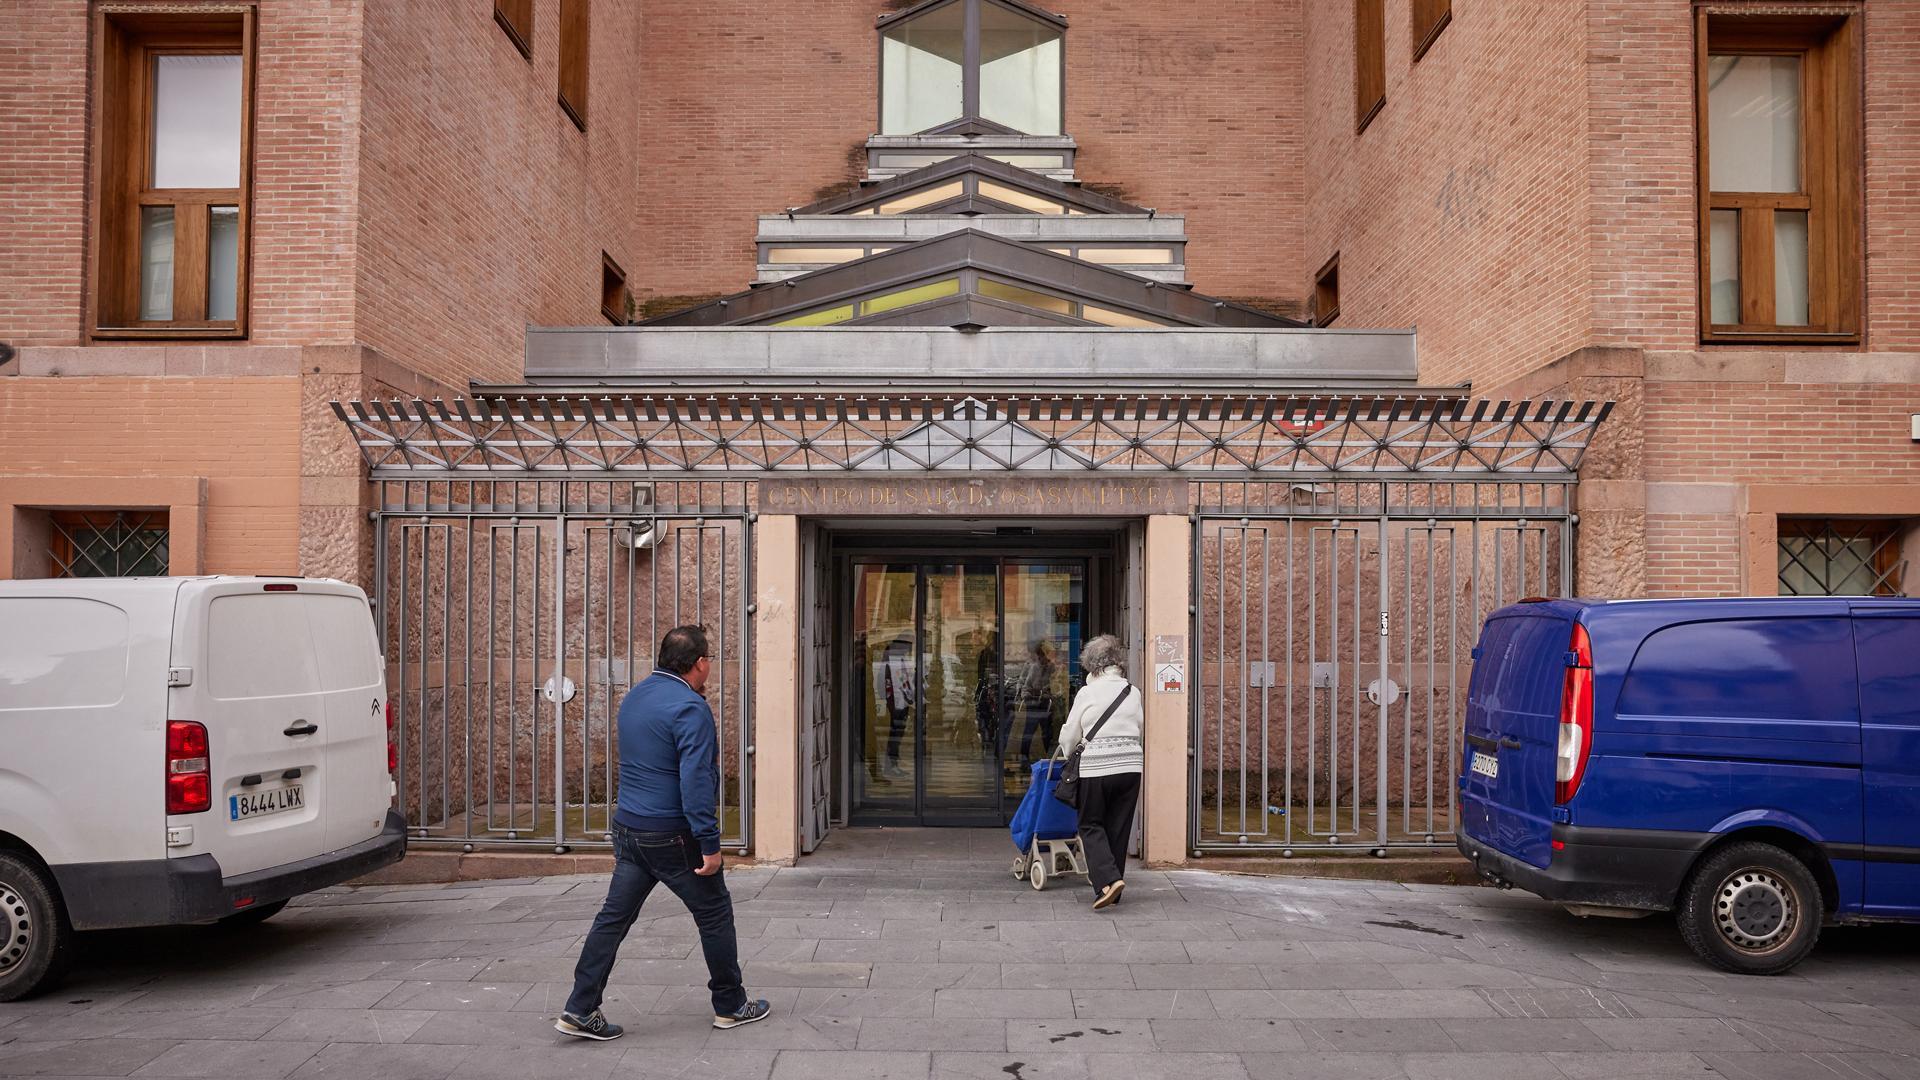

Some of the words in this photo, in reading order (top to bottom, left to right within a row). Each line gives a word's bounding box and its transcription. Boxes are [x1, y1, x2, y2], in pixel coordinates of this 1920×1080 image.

[869, 487, 898, 505] DE
[241, 793, 275, 815] 8444
[279, 787, 301, 808] LWX
